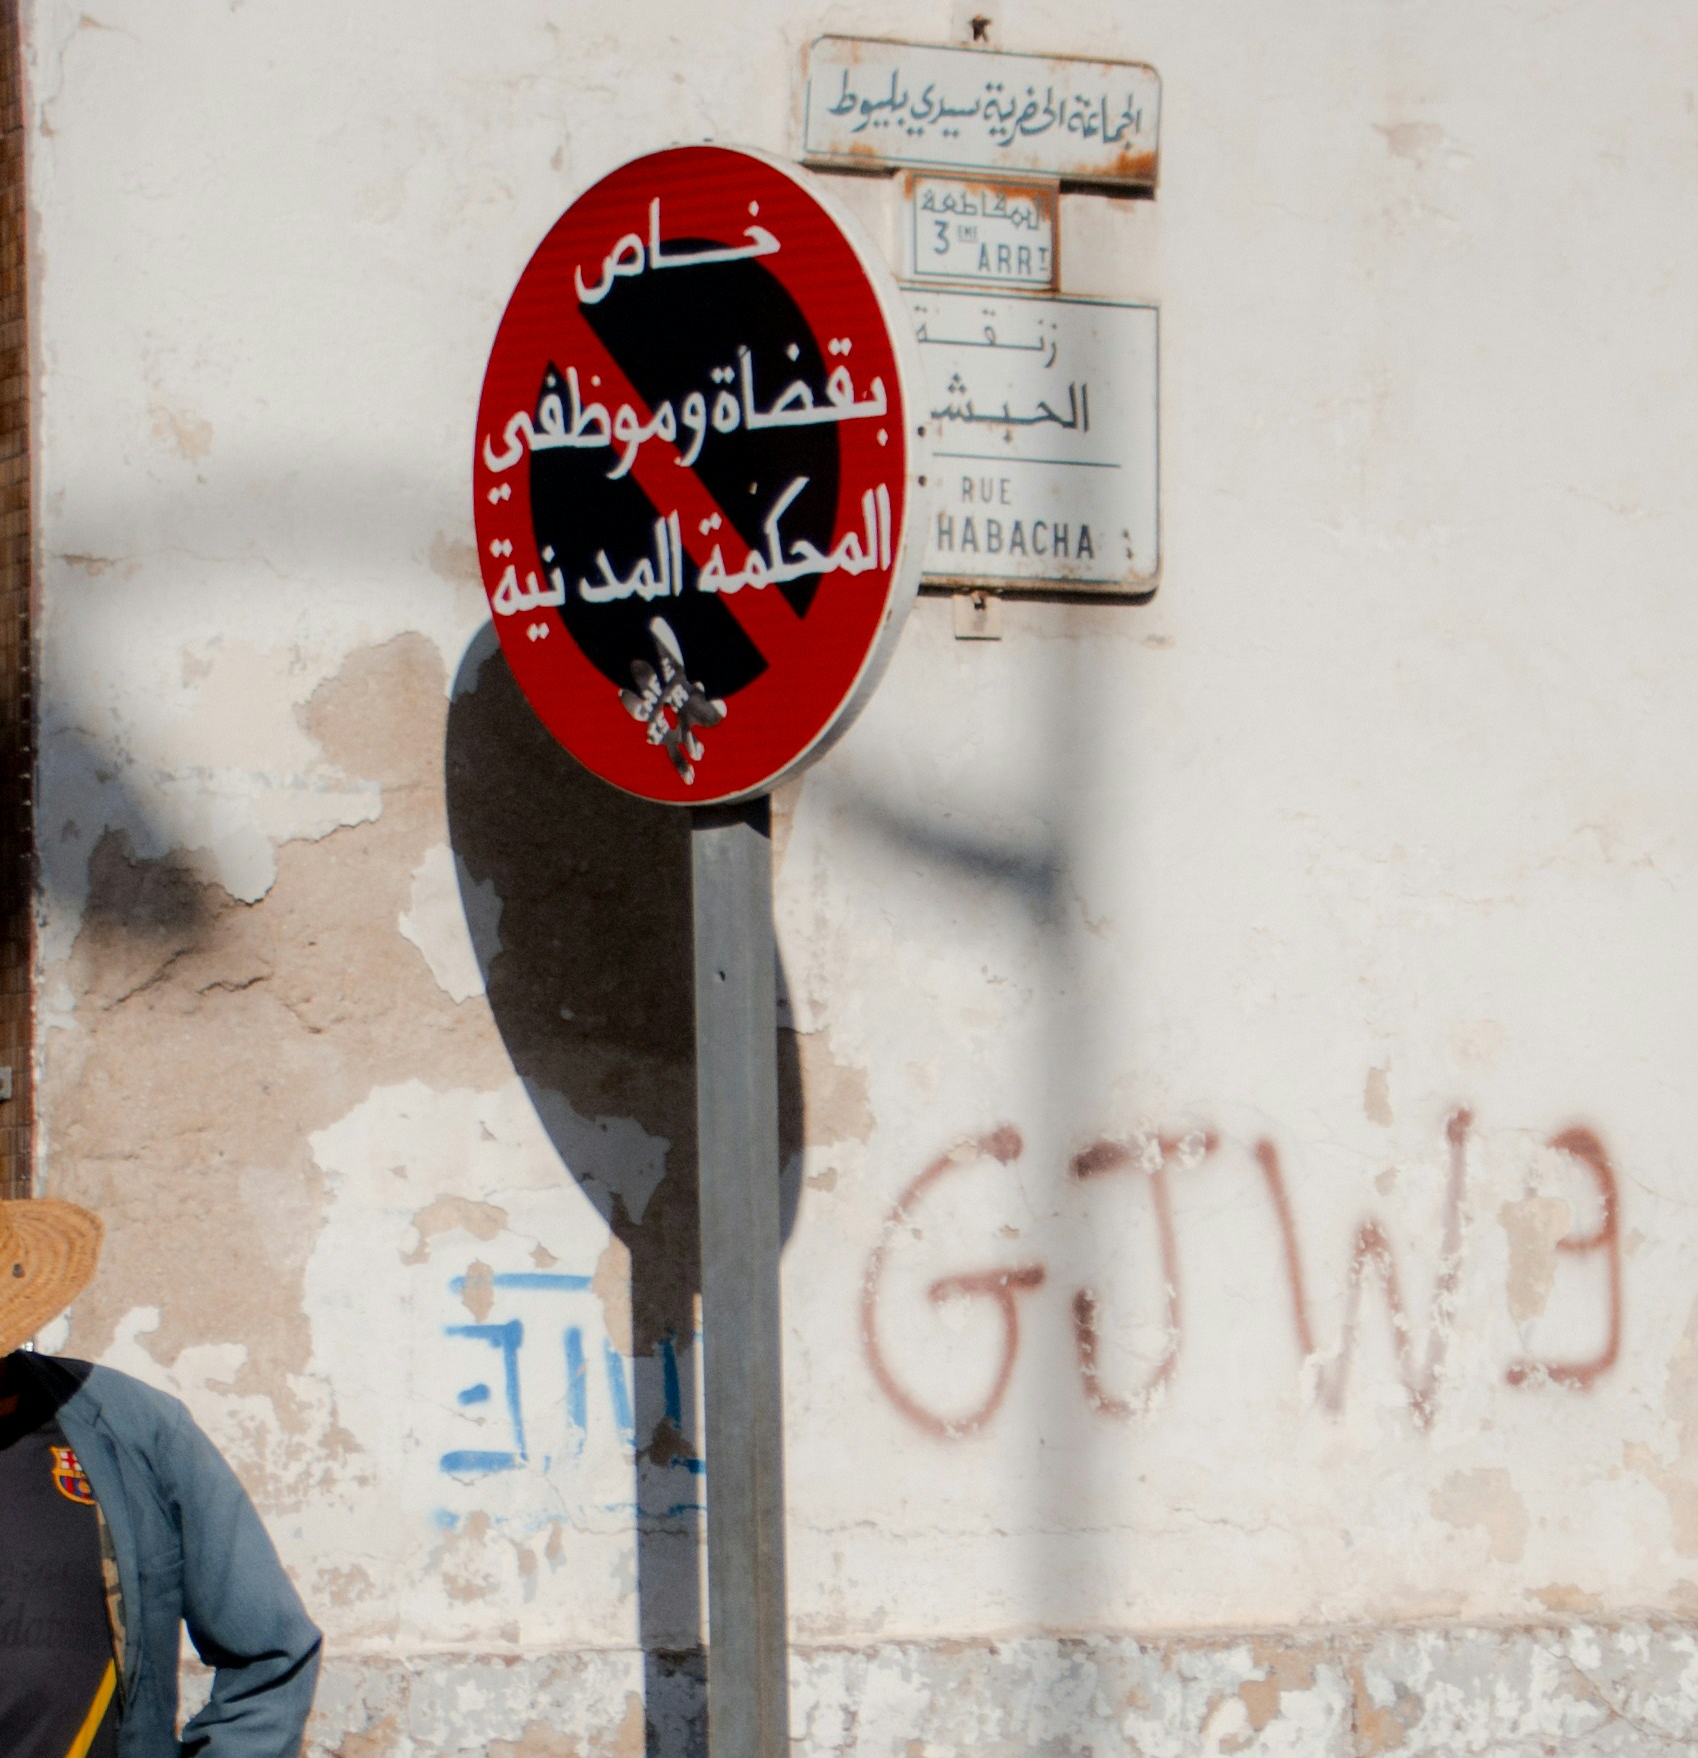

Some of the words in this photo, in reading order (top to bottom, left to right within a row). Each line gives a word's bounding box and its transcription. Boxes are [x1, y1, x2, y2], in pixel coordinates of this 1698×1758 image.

[827, 67, 909, 134] بليوط
[910, 82, 982, 138] سيدي
[983, 81, 1065, 147] الحضرية
[1067, 92, 1144, 149] الجماعة
[574, 196, 782, 305] خاص
[913, 305, 1058, 369] زنقة
[930, 372, 1090, 443] الحبش
[961, 475, 1012, 505] RUE
[697, 477, 892, 596] المحكمة
[936, 514, 1095, 560] HABACHA
[490, 510, 682, 642] المدنية
